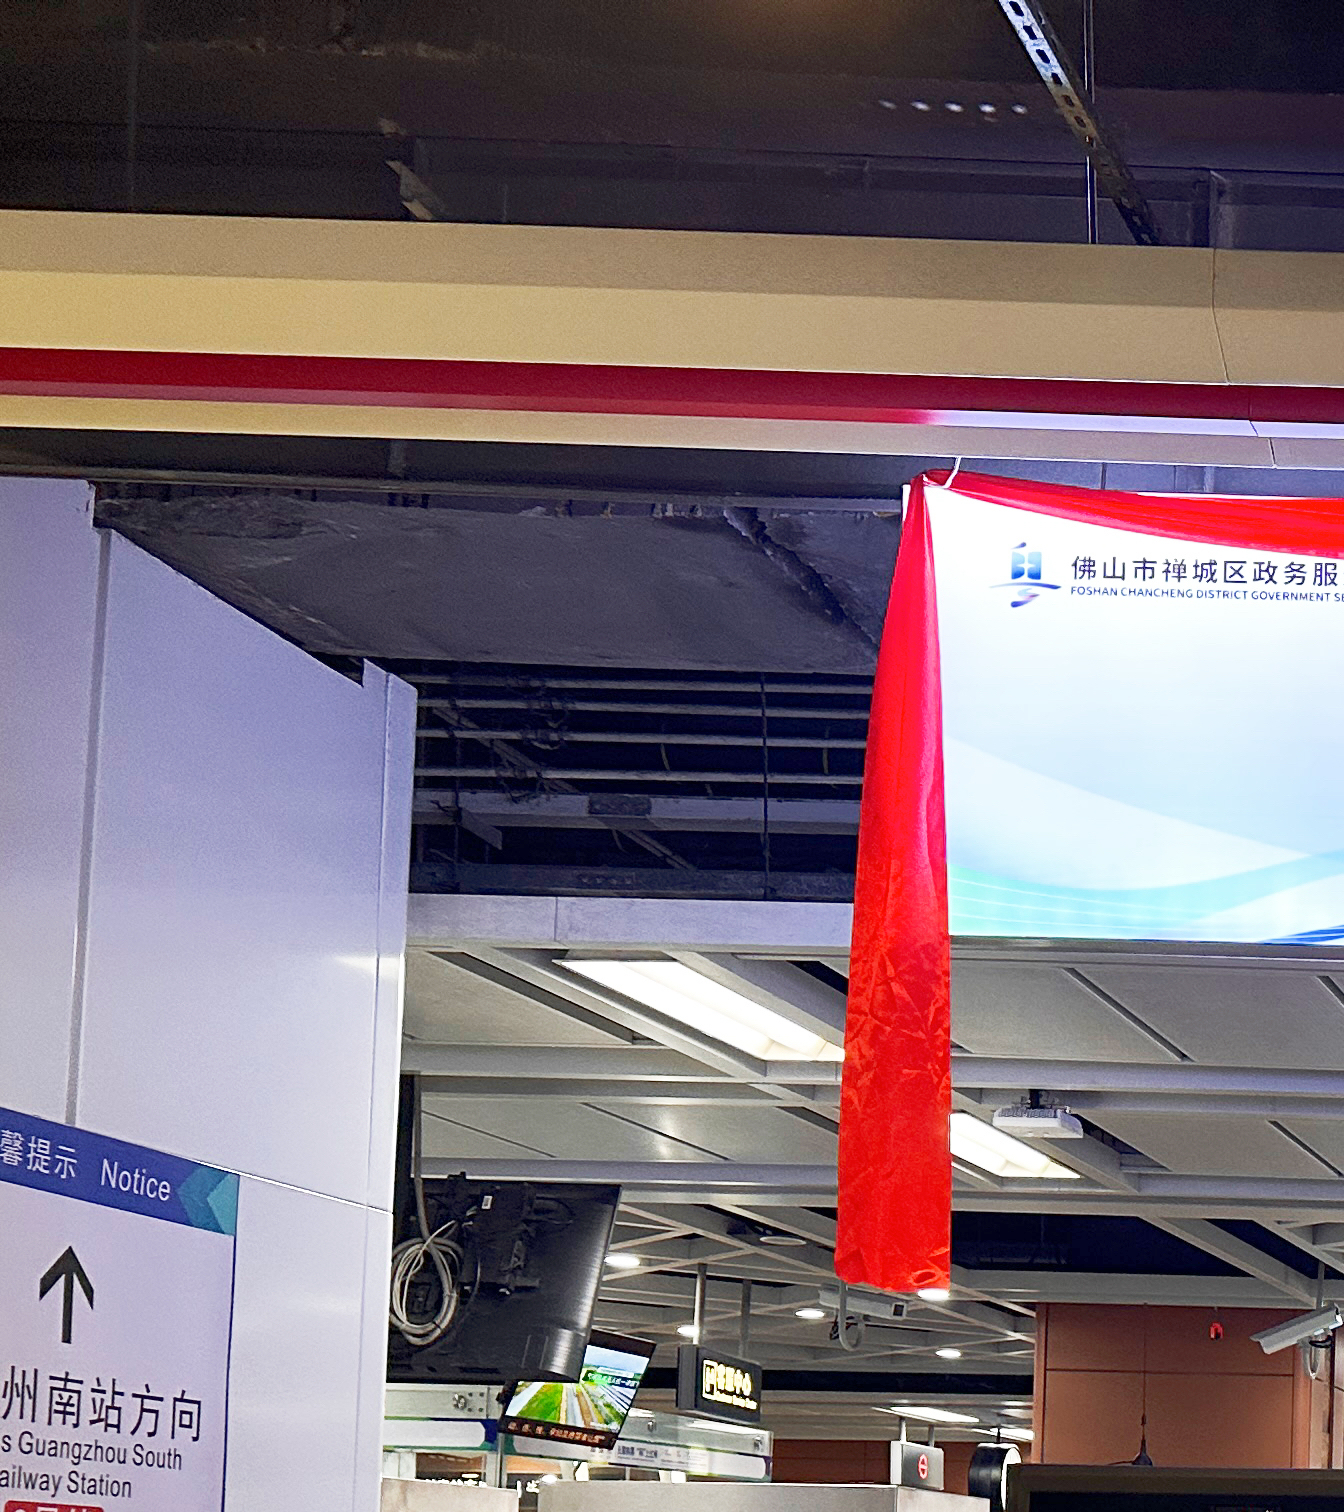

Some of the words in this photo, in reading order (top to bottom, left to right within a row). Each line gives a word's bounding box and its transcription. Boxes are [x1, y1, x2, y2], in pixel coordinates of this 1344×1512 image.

[1070, 587, 1119, 597] FOSHAN
[1120, 588, 1194, 599] CHANCHENG
[1196, 589, 1249, 600] DISTRICT
[1251, 591, 1331, 602] GOVERNMENT
[100, 1158, 171, 1201] Notice
[18, 1430, 127, 1466] Guangzhou
[132, 1443, 183, 1471] South
[66, 1469, 132, 1499] Station
